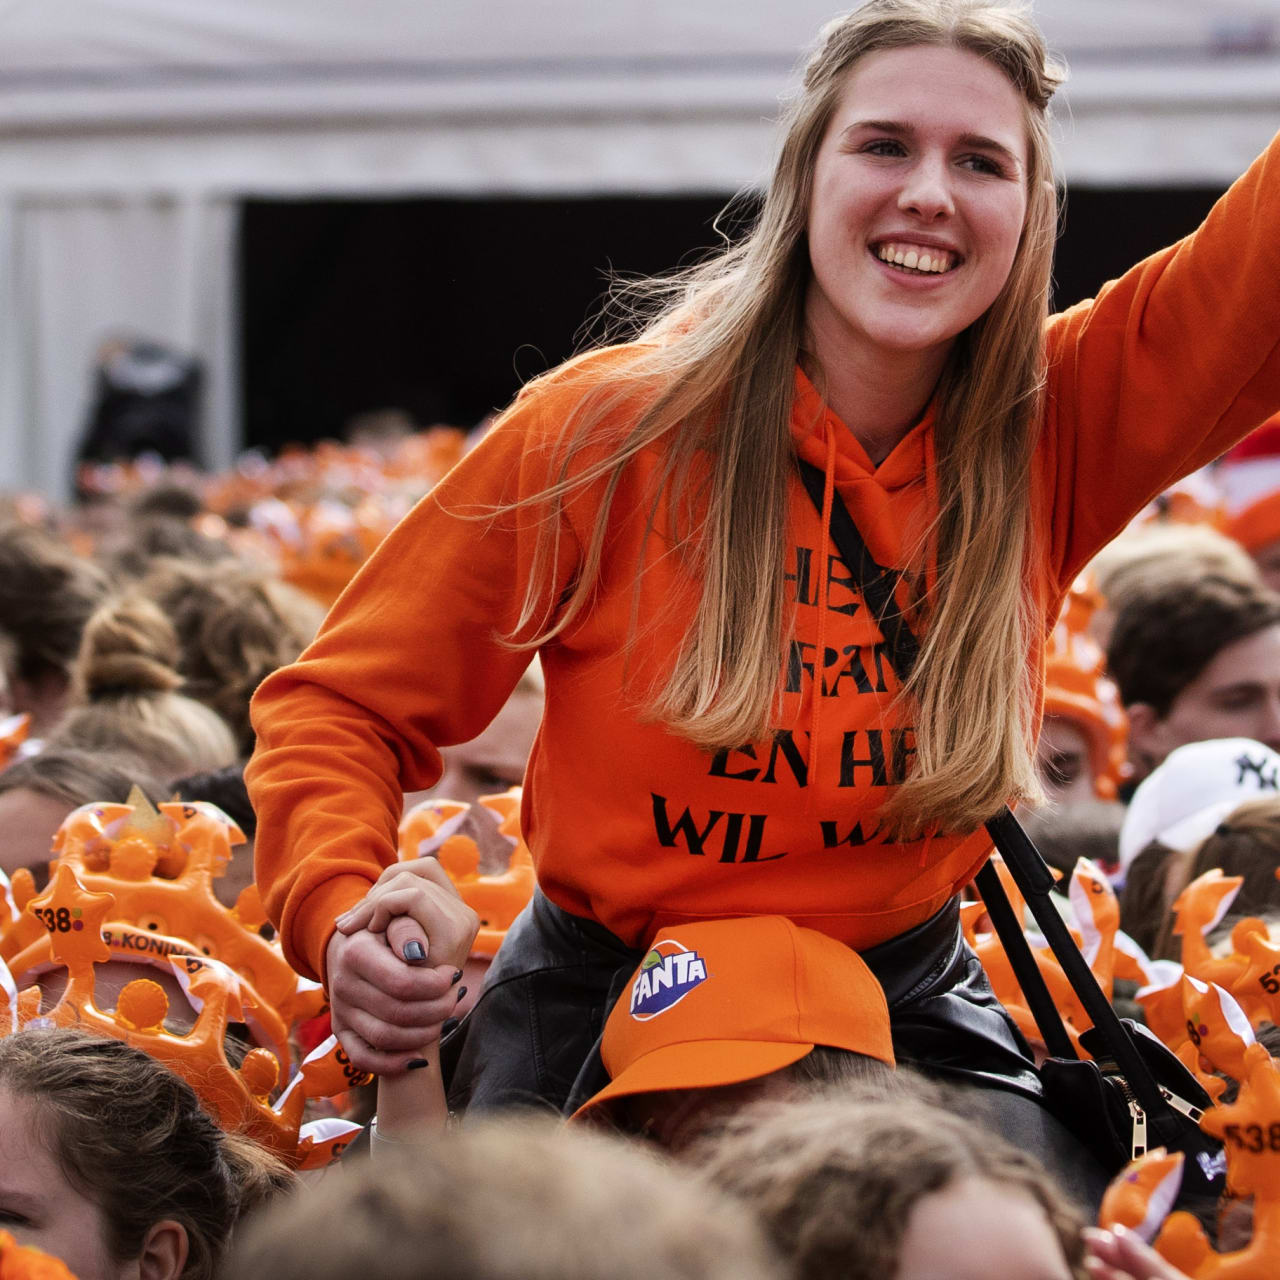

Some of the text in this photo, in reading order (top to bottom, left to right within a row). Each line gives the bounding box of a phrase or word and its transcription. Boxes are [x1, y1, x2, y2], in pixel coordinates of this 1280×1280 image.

[707, 726, 920, 789] EN HE
[650, 791, 789, 864] WIL
[630, 951, 706, 1014] FANTA
